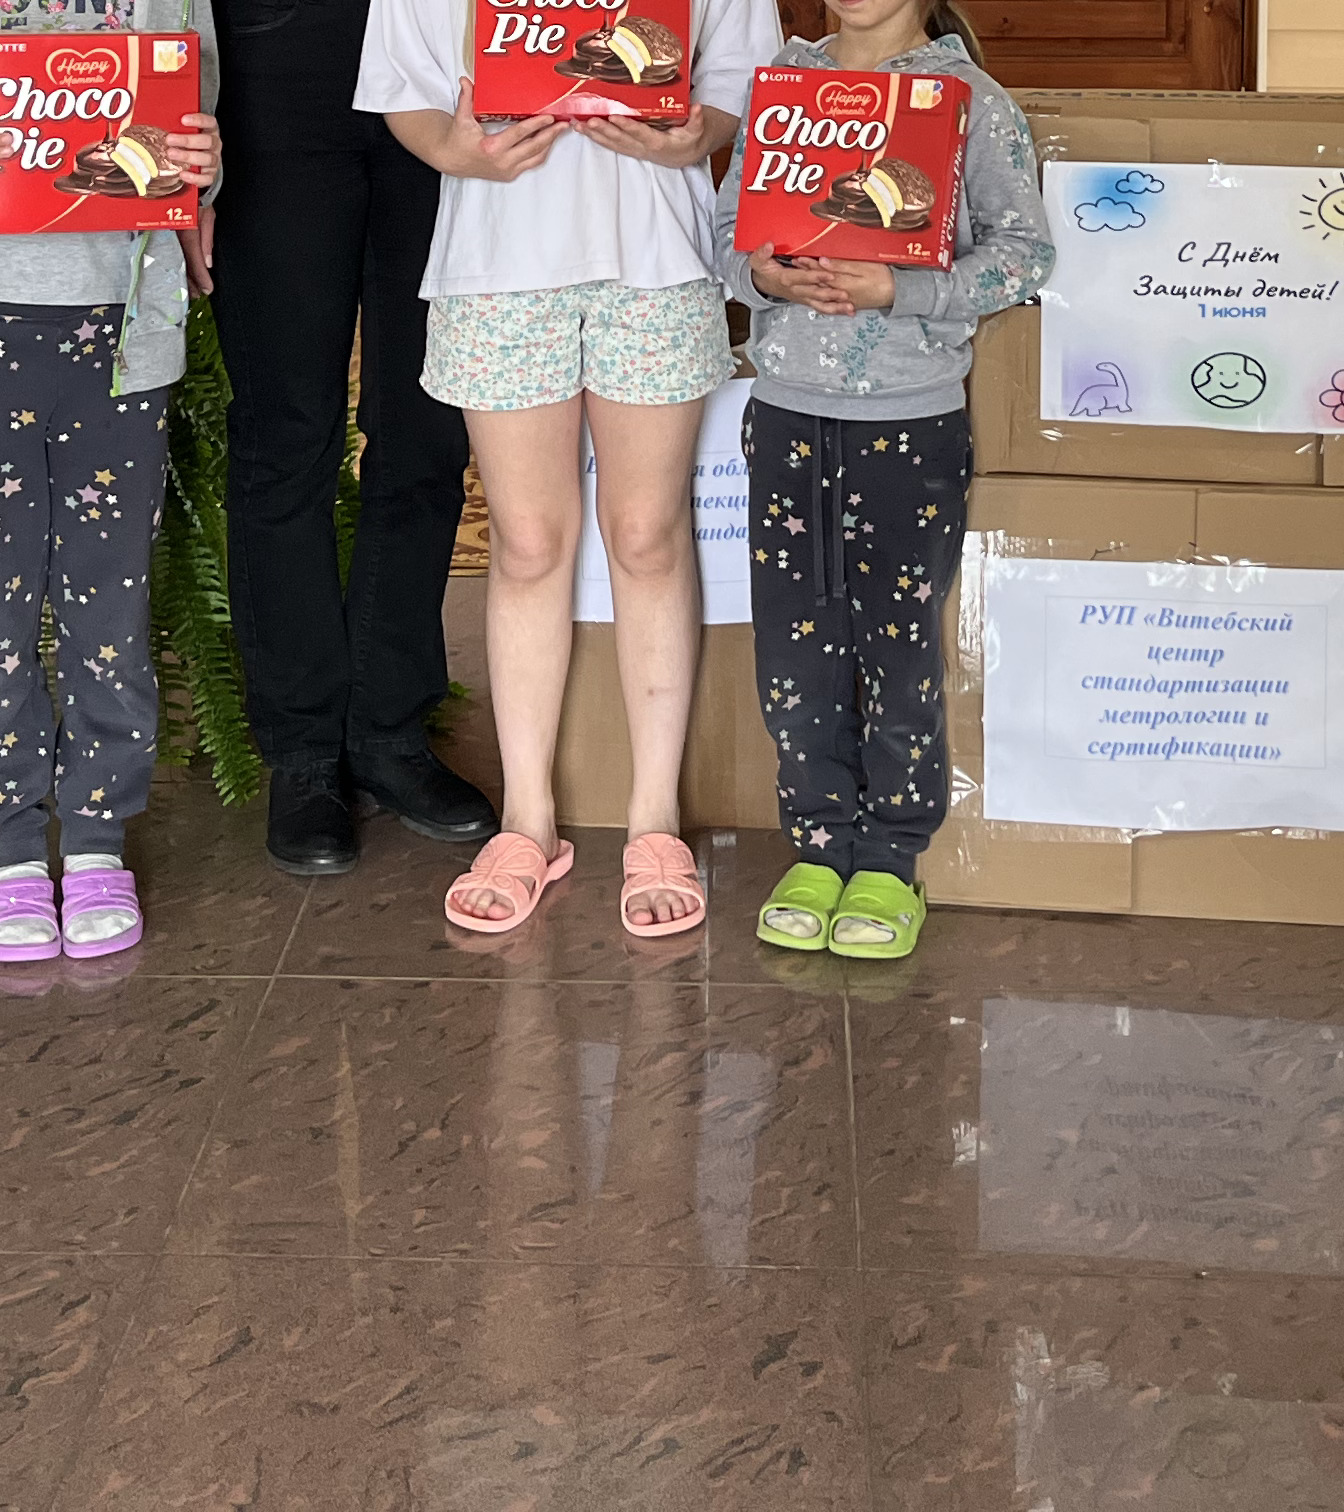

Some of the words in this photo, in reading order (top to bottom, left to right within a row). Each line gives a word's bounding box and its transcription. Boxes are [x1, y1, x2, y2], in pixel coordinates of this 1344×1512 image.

[483, 13, 565, 54] Pie
[57, 57, 110, 75] Happy
[769, 73, 803, 83] LOTTE
[659, 96, 675, 108] 12
[825, 90, 872, 106] Happy
[754, 105, 887, 150] Choco
[746, 150, 824, 194] Pie
[166, 207, 183, 220] 12
[907, 243, 922, 255] 12
[1177, 241, 1196, 262] С
[1202, 242, 1280, 268] Днём
[1133, 274, 1242, 299] Защиты
[1252, 278, 1340, 301] детей!
[1198, 303, 1206, 318] 1
[1079, 604, 1137, 627] РУП
[1143, 607, 1293, 633] «Витебский
[1147, 644, 1225, 668] центр
[1081, 672, 1289, 699] стандартизации
[1099, 706, 1248, 727] метрологии
[1254, 710, 1269, 727] и
[1087, 735, 1282, 762] сертификации»
